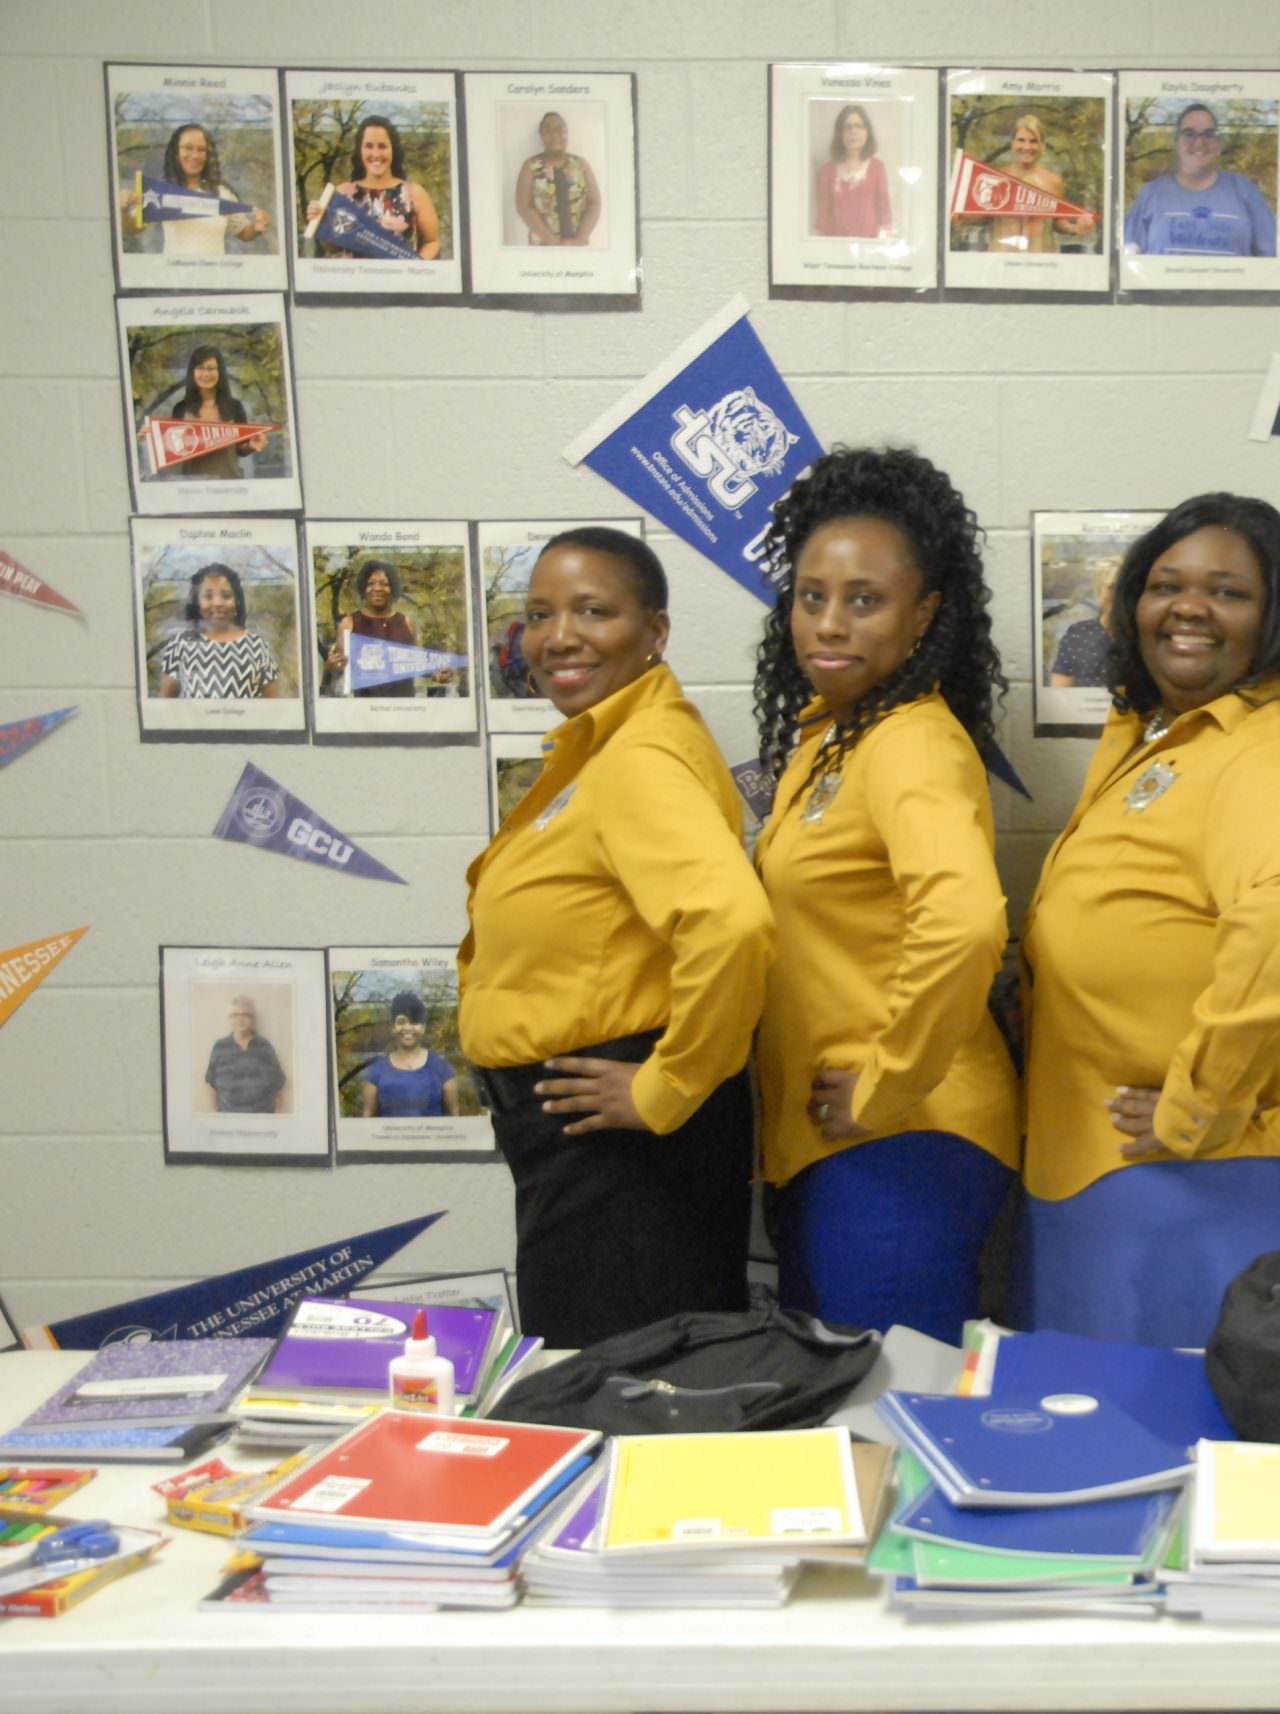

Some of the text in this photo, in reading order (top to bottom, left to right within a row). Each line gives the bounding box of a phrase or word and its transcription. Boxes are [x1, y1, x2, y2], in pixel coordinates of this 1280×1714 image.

[506, 83, 591, 96] Carolyn Sanders
[287, 817, 354, 865] GCU
[0, 935, 71, 1002] NESSEE
[187, 1246, 353, 1338] THE UNIVERSITY OF
[306, 1254, 375, 1297] MARTIN
